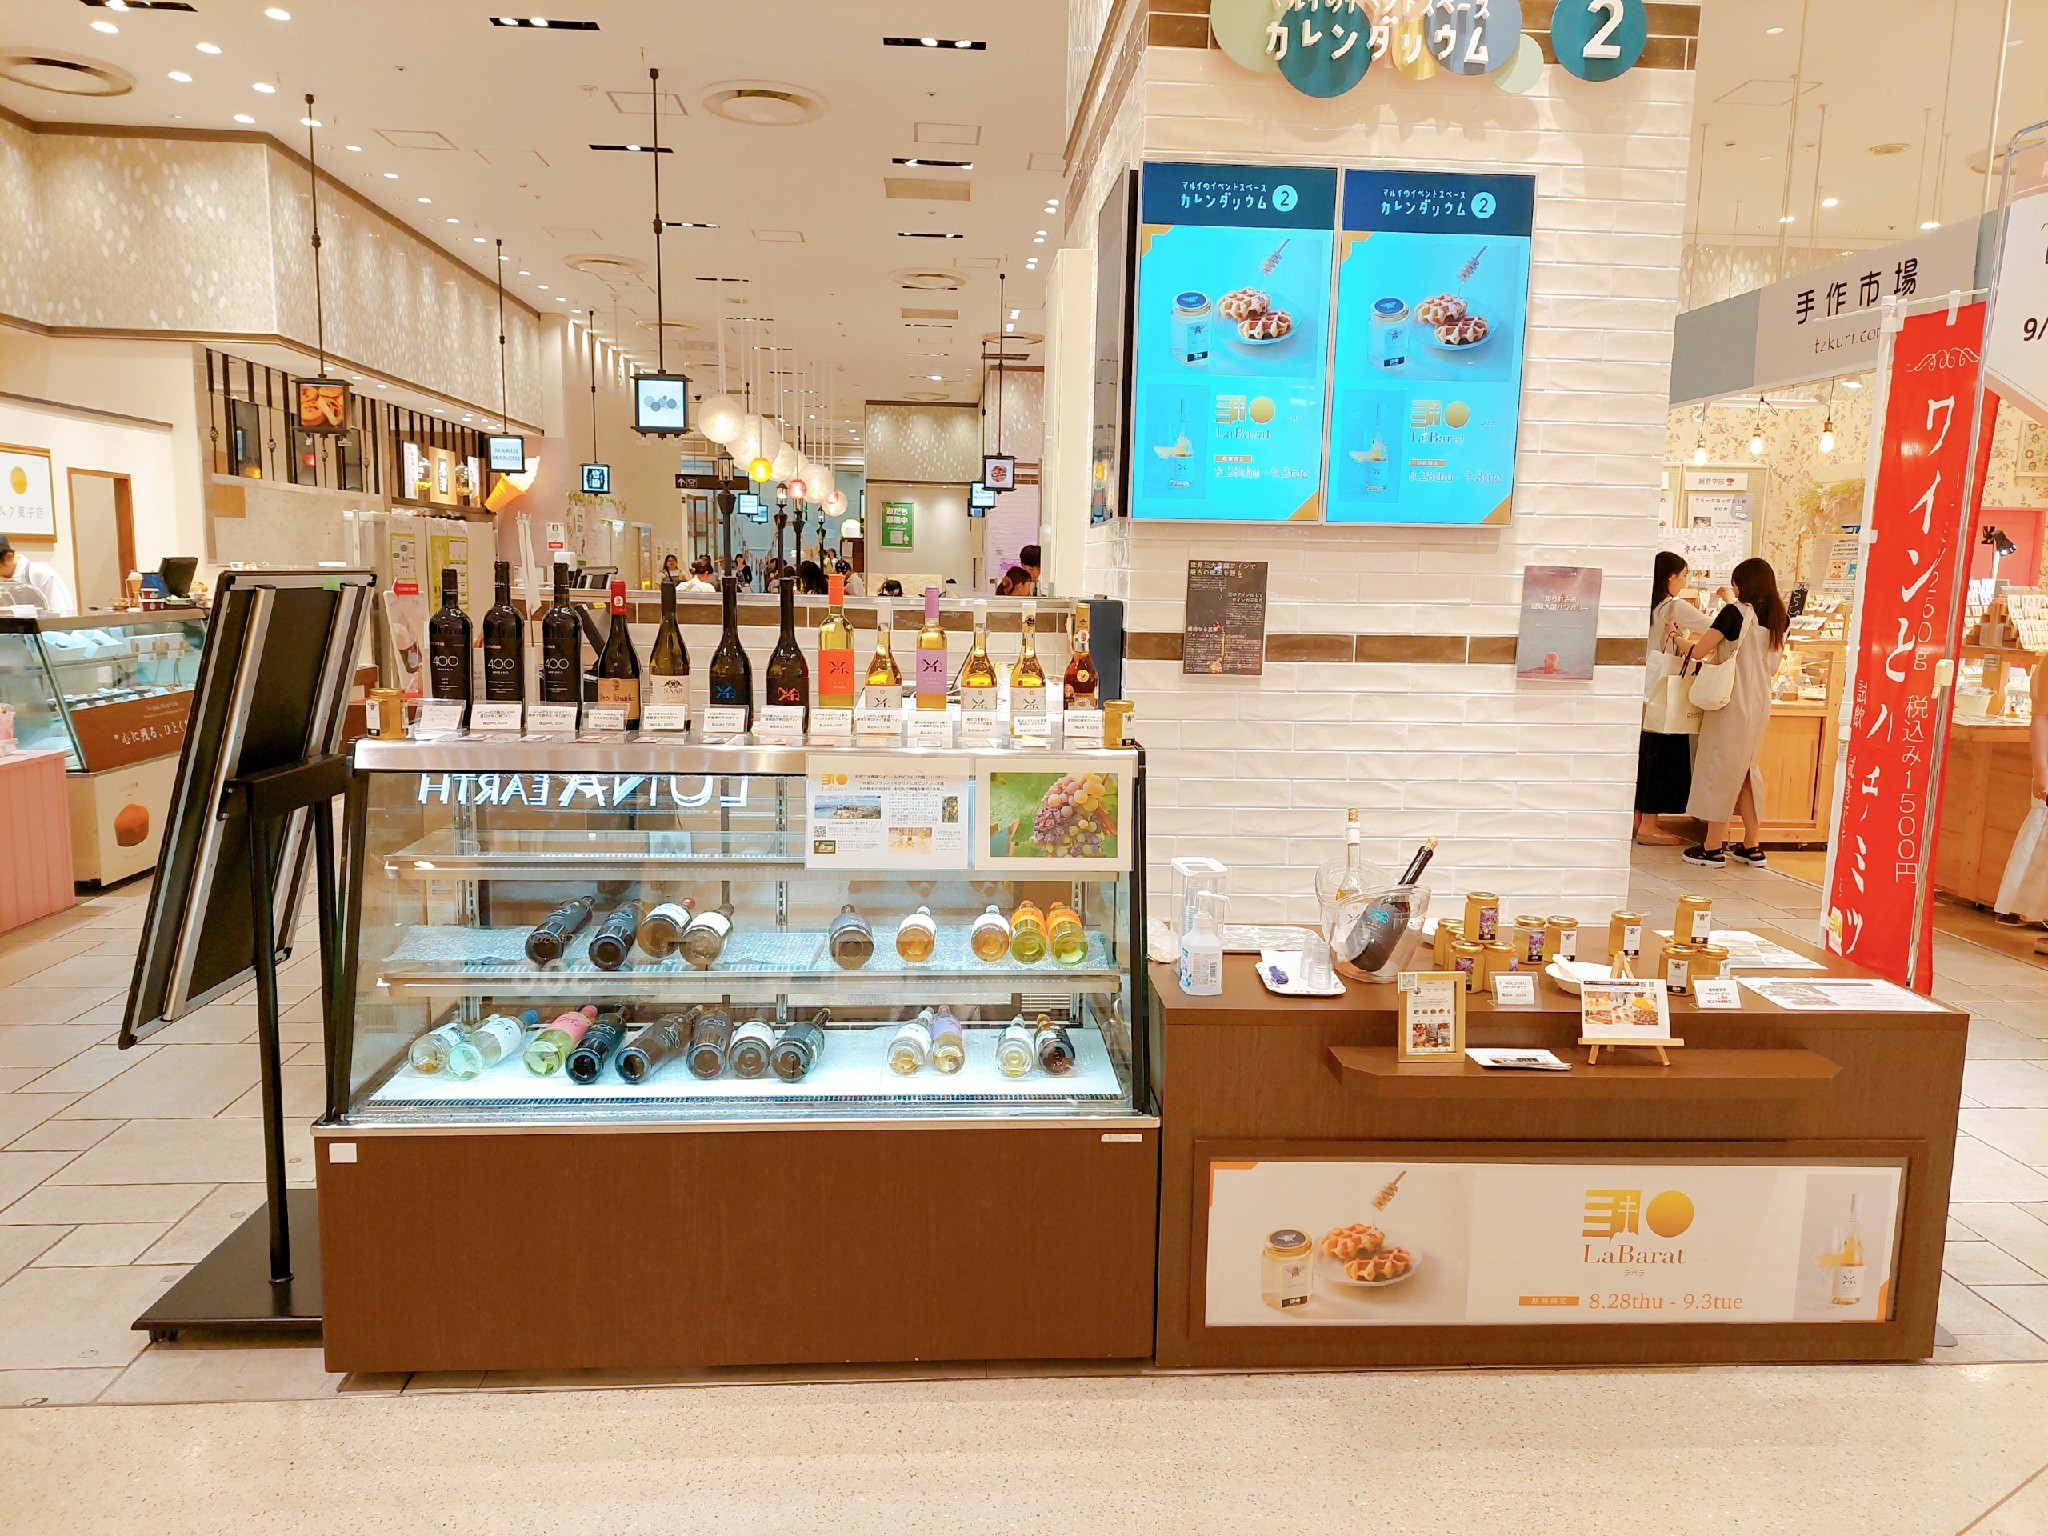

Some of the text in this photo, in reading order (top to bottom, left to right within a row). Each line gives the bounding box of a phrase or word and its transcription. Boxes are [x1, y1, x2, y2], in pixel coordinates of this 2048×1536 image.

[1265, 0, 1625, 66] カレンダリウム 2
[1182, 181, 1267, 193] マルイのイベントスペース
[1382, 188, 1467, 200] マルイのイベントスペース
[1181, 190, 1290, 210] カレンダリウム 2
[1381, 197, 1489, 217] カレンダリウム 2
[1796, 258, 1919, 326] 手作市場
[1215, 427, 1272, 440] LaBarat
[433, 655, 459, 667] 400
[487, 658, 515, 670] 400
[544, 657, 570, 670] 400
[1581, 1243, 1687, 1265] LaBarat
[1588, 1293, 1664, 1310] 8.28thu
[1682, 1293, 1744, 1310] 9.3tue
